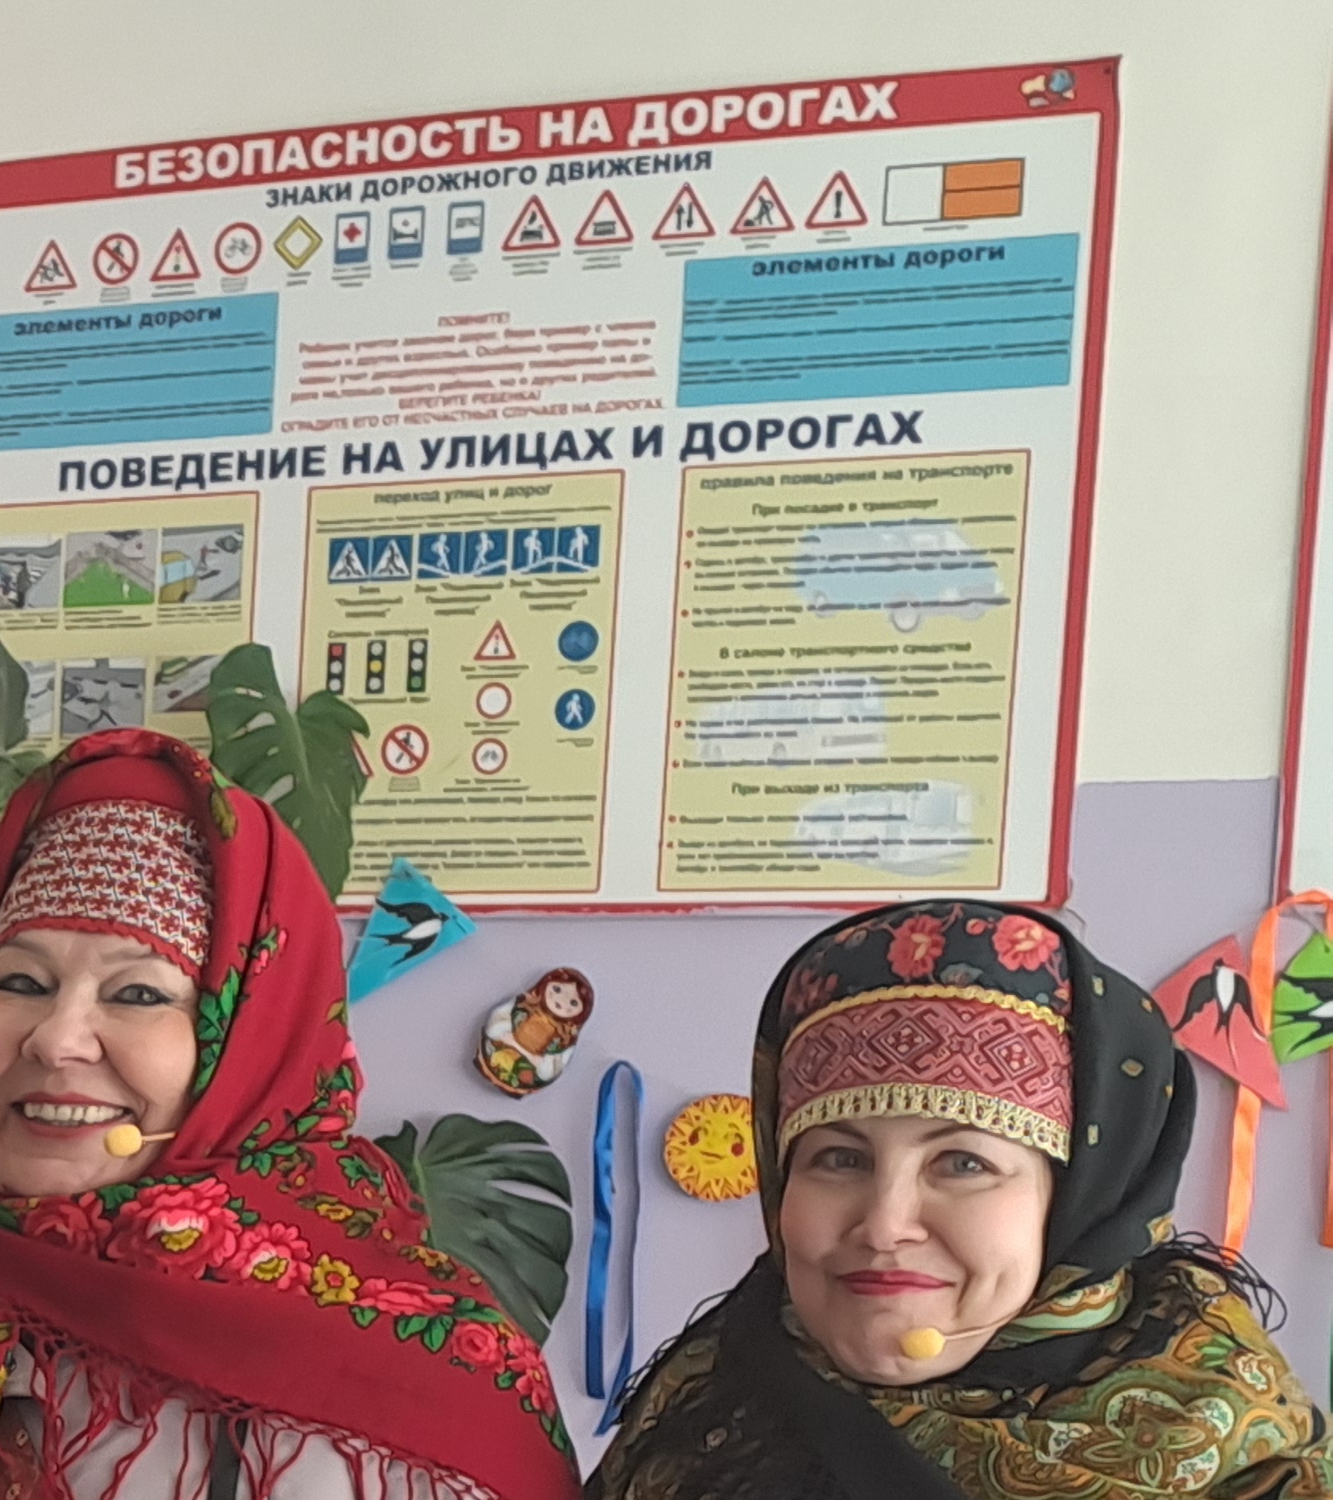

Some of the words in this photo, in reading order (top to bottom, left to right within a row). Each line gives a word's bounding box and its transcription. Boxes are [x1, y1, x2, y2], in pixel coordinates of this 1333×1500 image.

[114, 116, 521, 189] БЕЗОПАСНОСТЬ
[538, 107, 613, 148] НА
[628, 81, 899, 147] ДОРОГАХ
[265, 183, 352, 208] ЗНАКИ
[360, 165, 537, 203] ДОРОЖНОГО
[545, 150, 713, 186] ДВИЖЕНИЯ
[903, 245, 1005, 269] дороги
[138, 307, 222, 330] дороги
[59, 445, 326, 491] ПОВЕДЕНИЕ
[343, 440, 403, 475] НА
[420, 427, 614, 471] УЛИЦАХ
[632, 425, 664, 459] И
[679, 410, 925, 462] ДОРОГАХ
